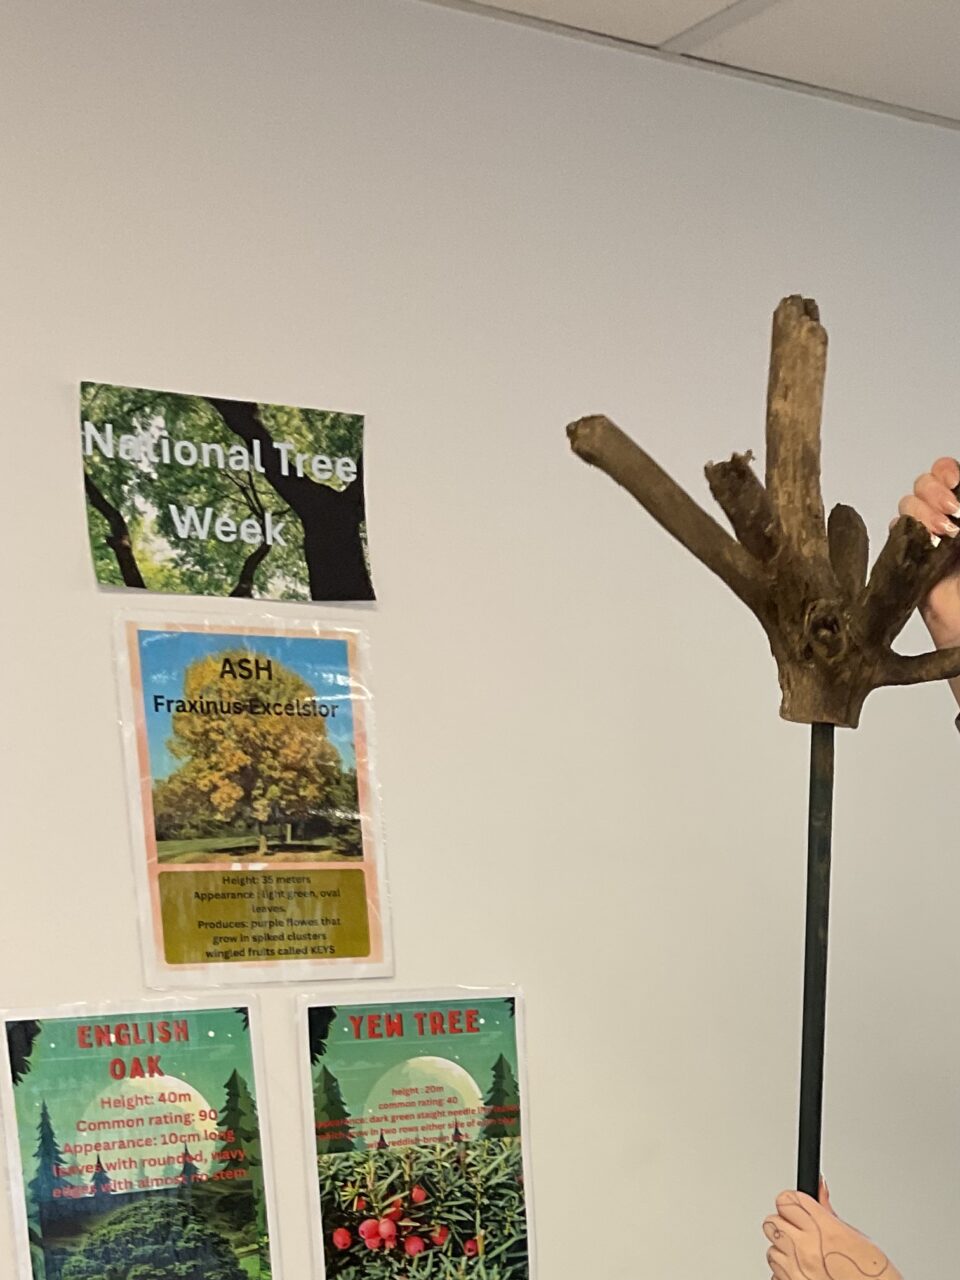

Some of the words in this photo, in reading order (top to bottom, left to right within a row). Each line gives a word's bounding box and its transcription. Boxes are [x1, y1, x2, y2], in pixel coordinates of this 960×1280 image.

[83, 421, 265, 473] National
[273, 441, 357, 482] Tree
[169, 504, 286, 546] Week
[219, 658, 273, 680] ASH
[153, 695, 243, 716] Fraxinus
[249, 697, 339, 718] Excelsior
[222, 876, 259, 887] Height:
[277, 876, 311, 884] meters
[194, 891, 254, 902] Appearance
[320, 889, 340, 898] oval
[321, 918, 341, 926] that
[212, 936, 237, 945] grow
[240, 934, 249, 942] in
[252, 933, 284, 943] spiked
[288, 932, 327, 941] clusters
[278, 946, 308, 955] called
[311, 945, 335, 954] KEYS
[77, 1018, 190, 1048] ENGLISH
[349, 1012, 404, 1040] YEW
[413, 1009, 481, 1036] TREE
[109, 1055, 165, 1081] OAK
[100, 1095, 154, 1110] Height:
[158, 1091, 191, 1104] 40m
[425, 1086, 444, 1095] 20m
[379, 1101, 416, 1110] common
[76, 1117, 144, 1132] Common
[149, 1112, 195, 1126] rating:
[198, 1109, 218, 1121] 90
[369, 1115, 388, 1124] dark
[391, 1114, 415, 1124] green
[64, 1135, 157, 1155] Appearance:
[161, 1132, 199, 1145] 10cm
[204, 1128, 235, 1143] long
[105, 1157, 137, 1171] with
[142, 1151, 207, 1168] rounded,
[211, 1149, 245, 1162] wavy
[101, 1178, 133, 1193] with
[138, 1173, 188, 1189] almost
[191, 1171, 209, 1182] no
[213, 1167, 247, 1180] stem
